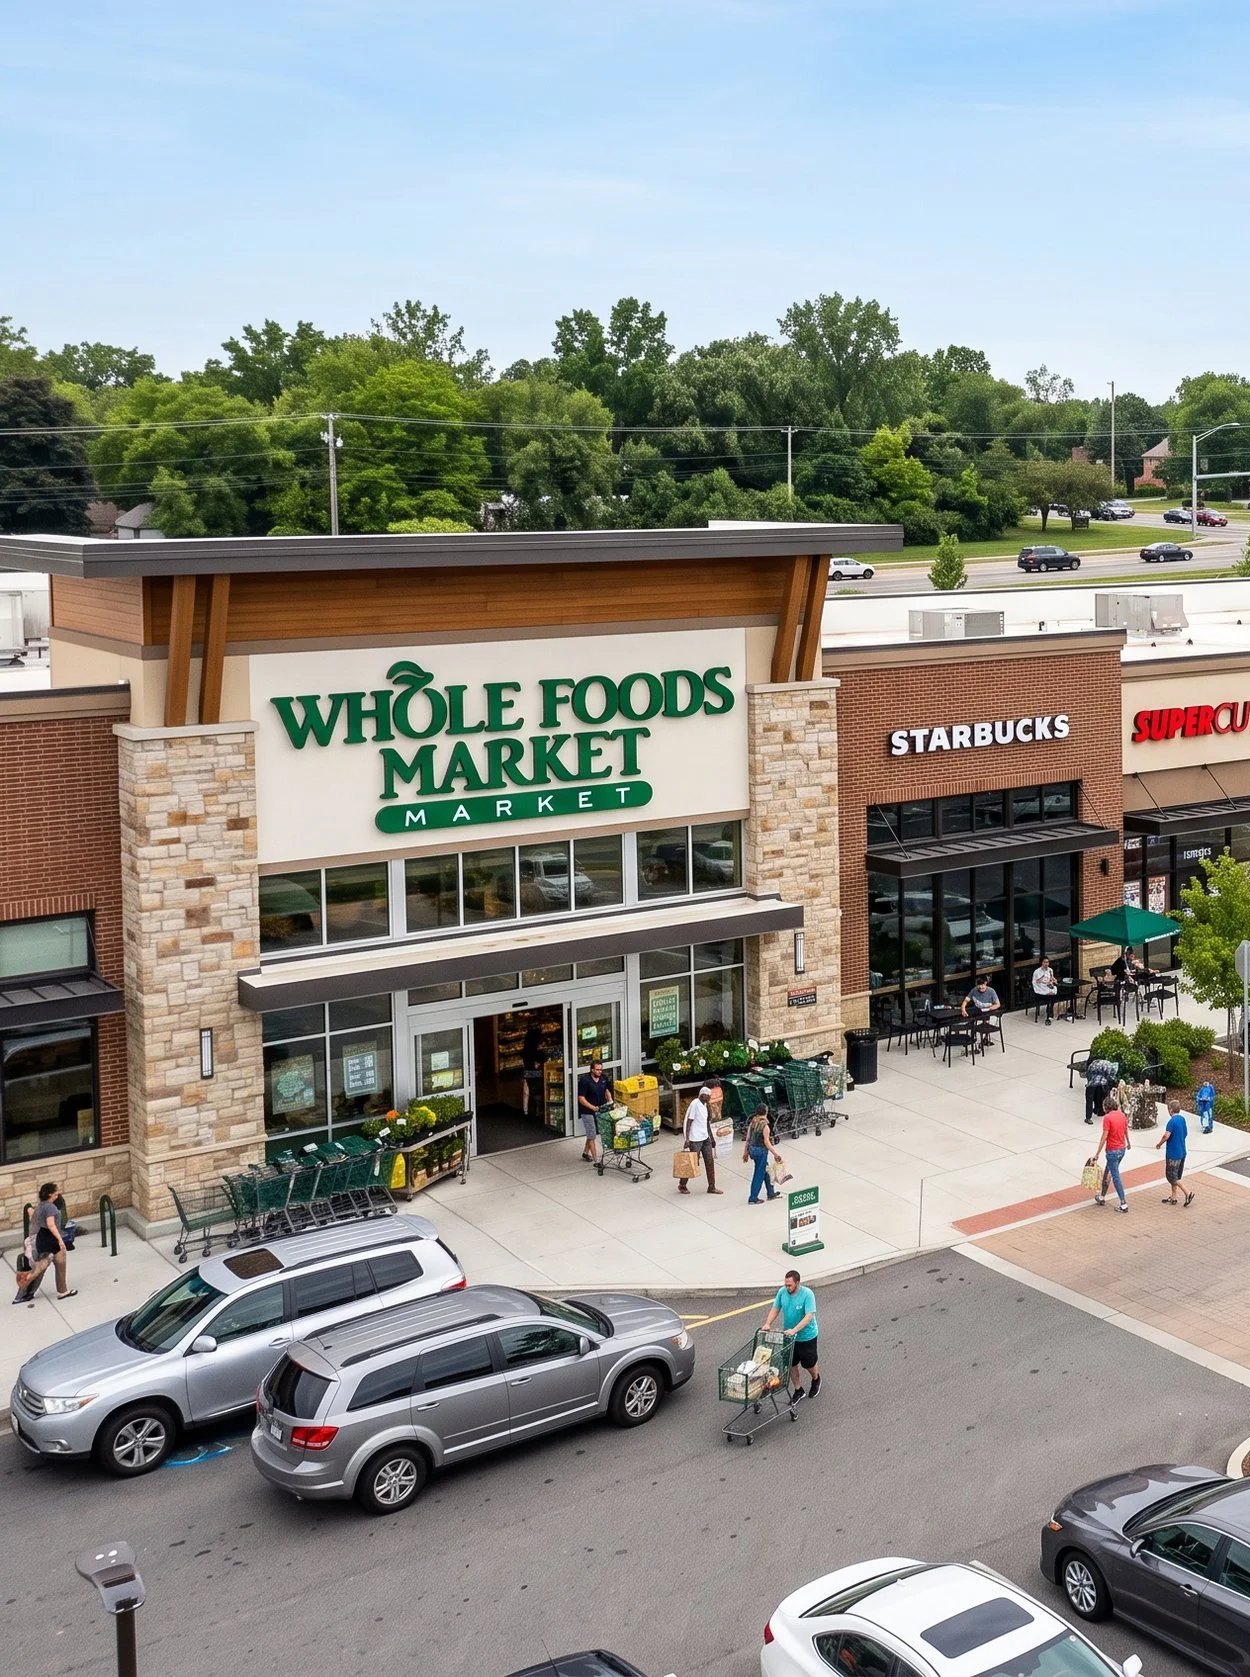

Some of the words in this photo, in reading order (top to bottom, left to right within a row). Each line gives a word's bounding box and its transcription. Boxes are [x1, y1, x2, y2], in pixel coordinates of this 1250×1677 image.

[270, 661, 524, 750] WHOLE
[539, 666, 735, 728] FOODS
[379, 727, 651, 800] MARKET
[889, 714, 1070, 756] STARBUCKS
[404, 786, 632, 828] MARKET
